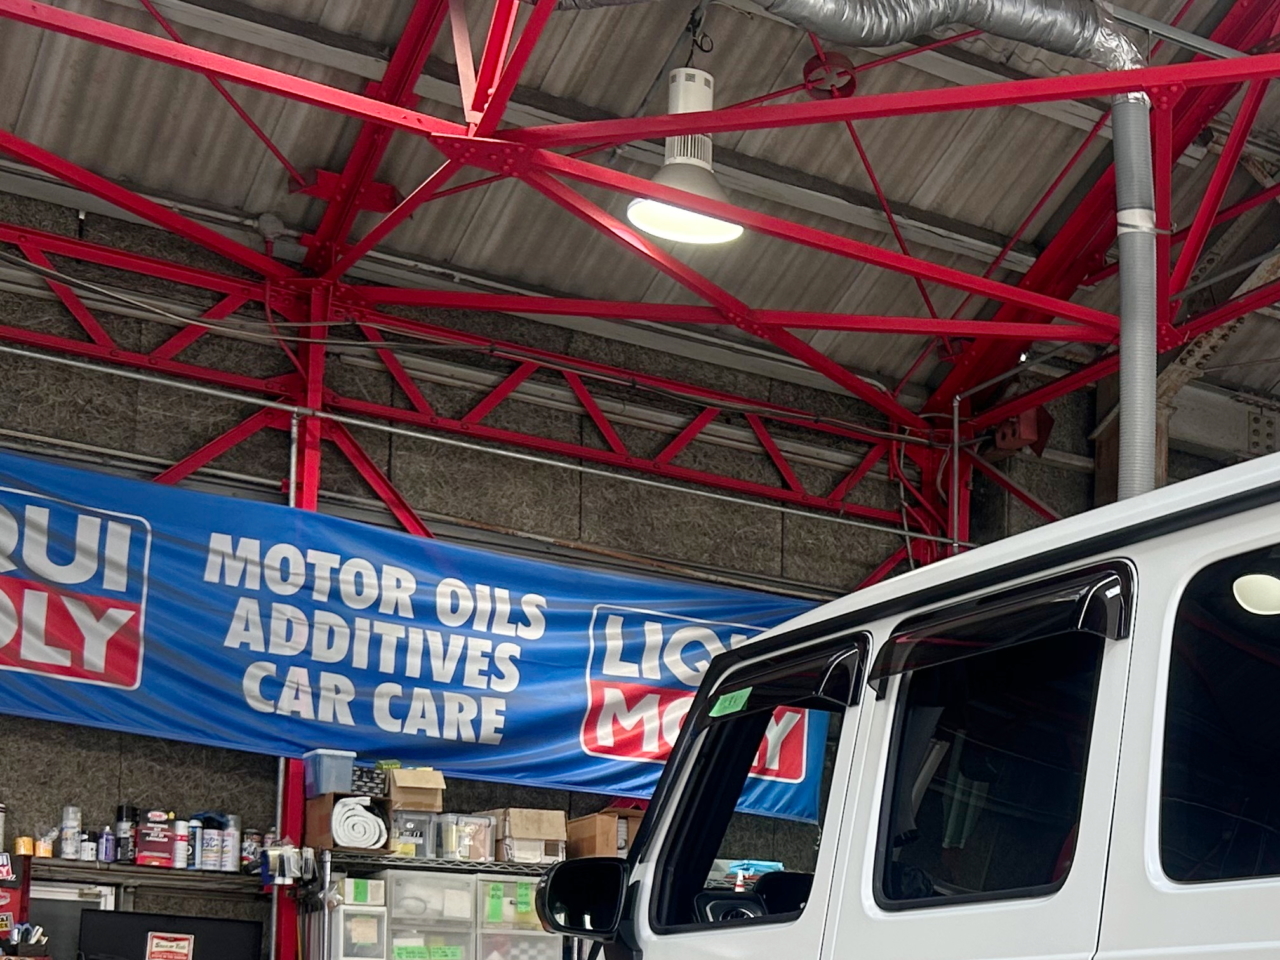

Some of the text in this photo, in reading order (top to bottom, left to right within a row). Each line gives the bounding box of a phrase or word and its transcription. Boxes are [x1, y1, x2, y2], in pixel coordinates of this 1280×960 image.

[0, 504, 131, 592] UI
[204, 532, 547, 640] MOTOR OILS
[0, 588, 136, 673] LY
[224, 596, 521, 693] ADDITIVES
[602, 615, 747, 687] LIQ
[242, 661, 506, 745] CAR CARE
[597, 687, 802, 771] MY
